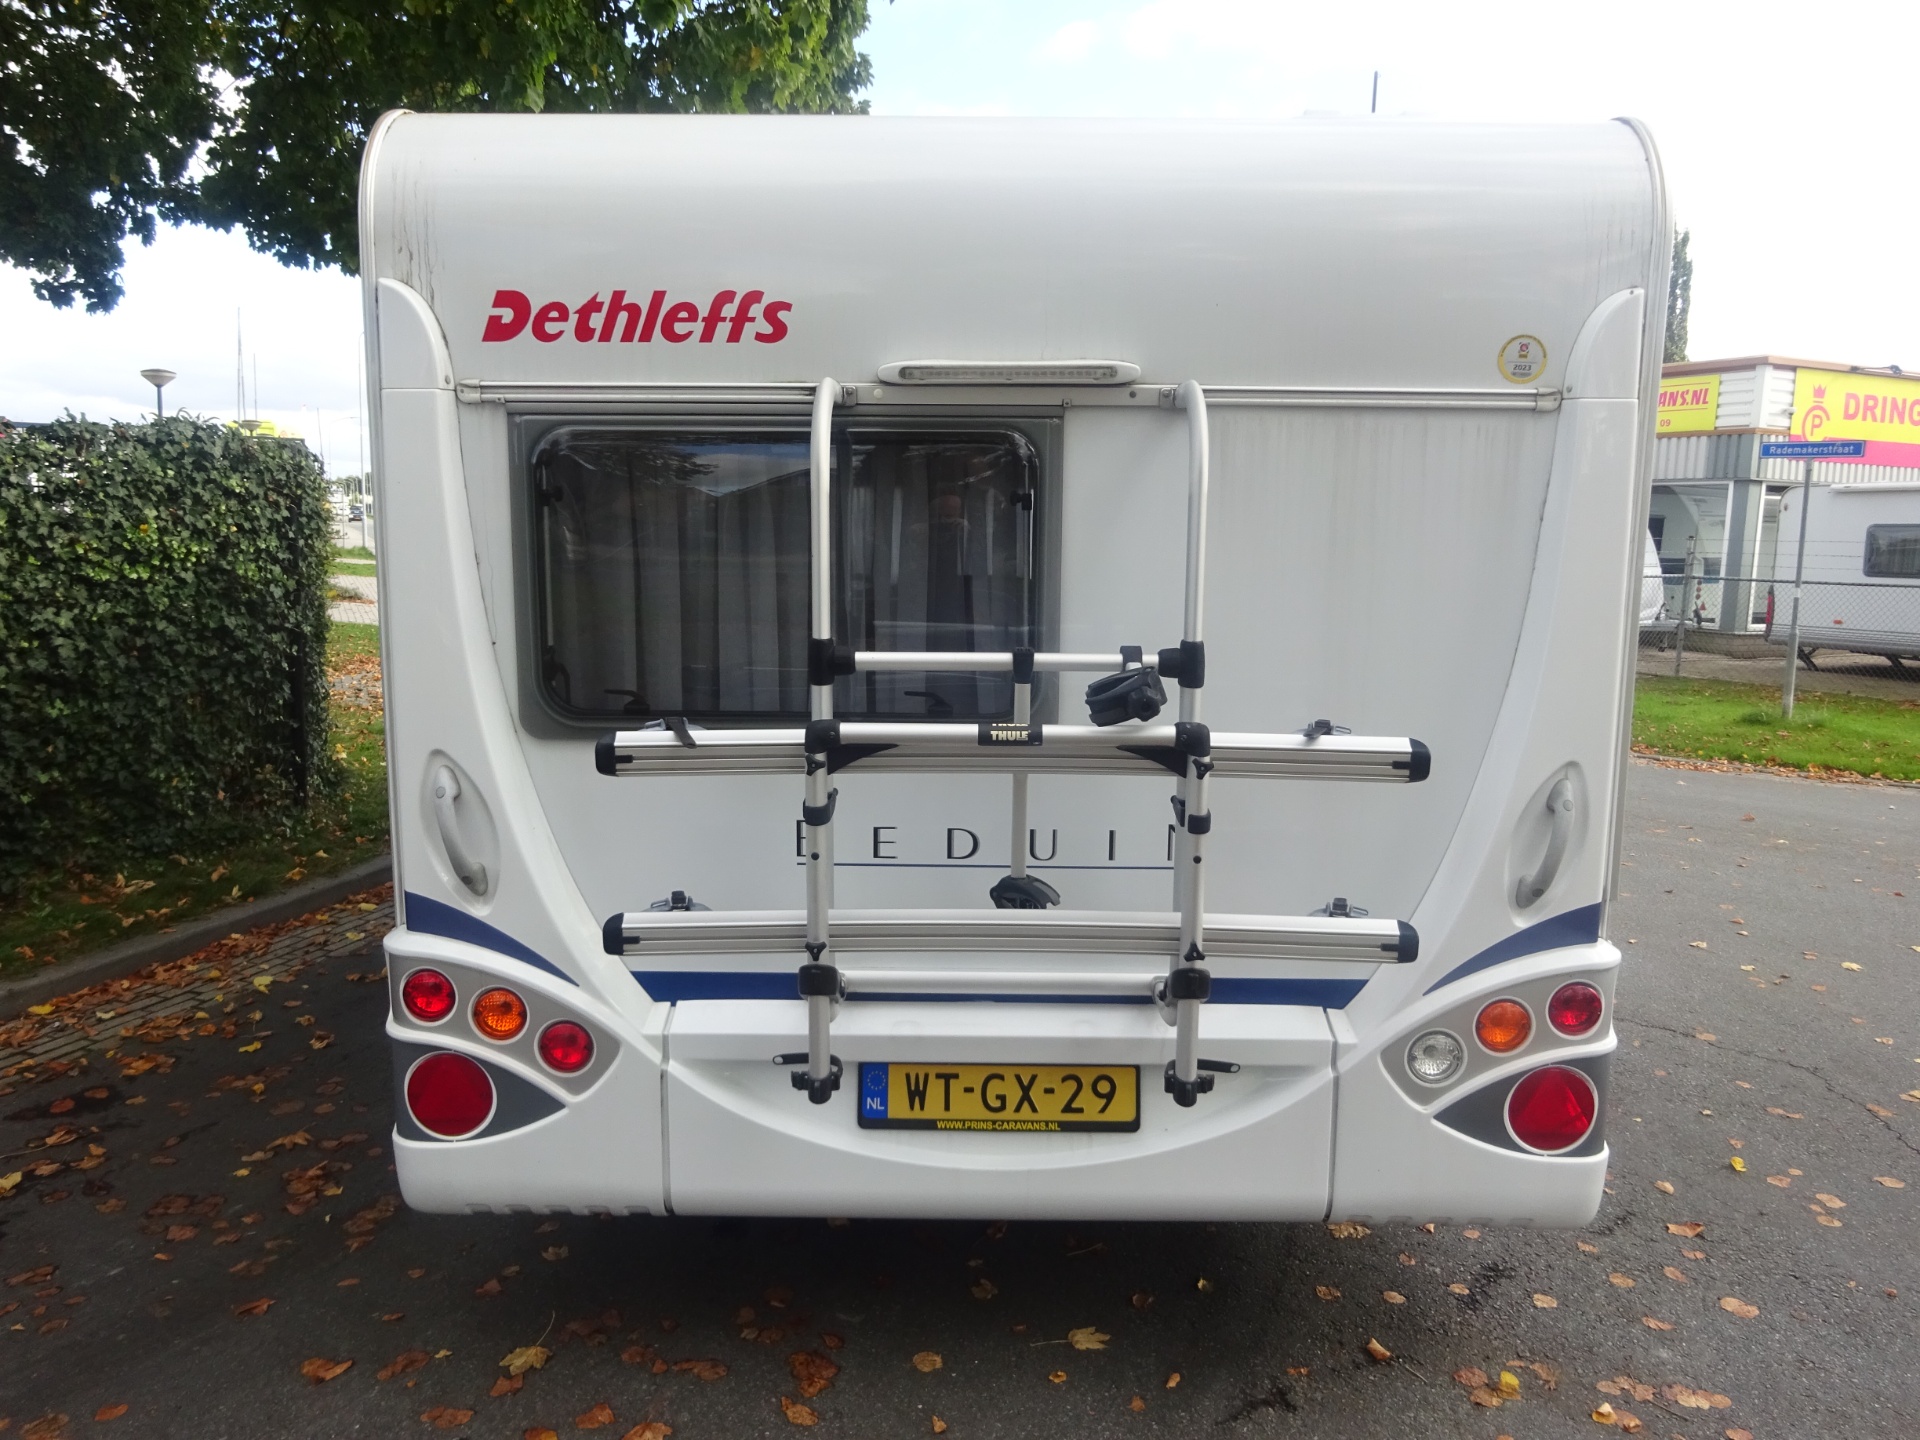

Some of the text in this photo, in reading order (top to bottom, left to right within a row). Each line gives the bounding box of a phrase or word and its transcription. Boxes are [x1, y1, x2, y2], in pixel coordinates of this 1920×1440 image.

[481, 289, 793, 344] Dethleffs
[1769, 446, 1854, 454] Rademakerstraat
[990, 730, 1029, 740] THULE
[796, 820, 1176, 861] EDUI
[905, 1072, 1117, 1114] WT-GX-29
[866, 1096, 885, 1110] NL
[937, 1120, 1061, 1132] WWW.PRINS-CARAVANS.NL
